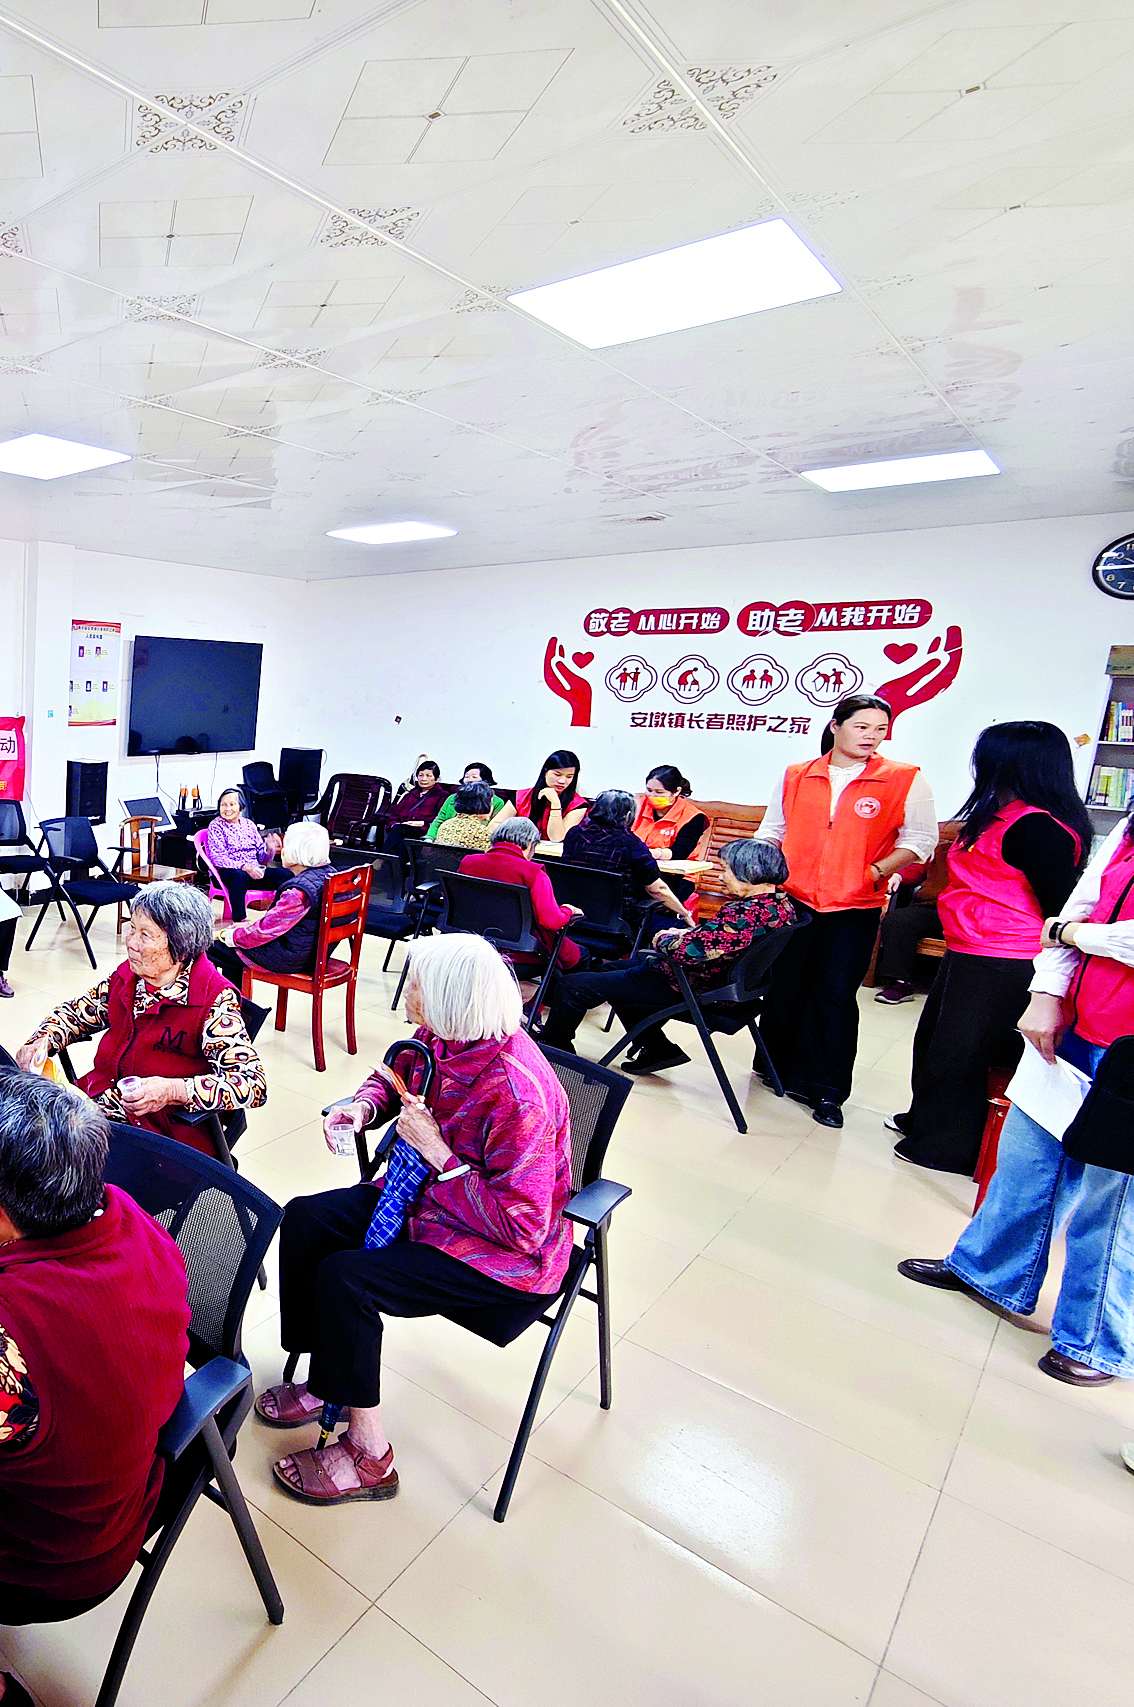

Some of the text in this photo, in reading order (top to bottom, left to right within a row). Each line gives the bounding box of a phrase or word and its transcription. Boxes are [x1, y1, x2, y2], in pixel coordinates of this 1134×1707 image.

[1117, 581, 1127, 589] 7
[629, 711, 812, 735] 安墩镇长者照护之家
